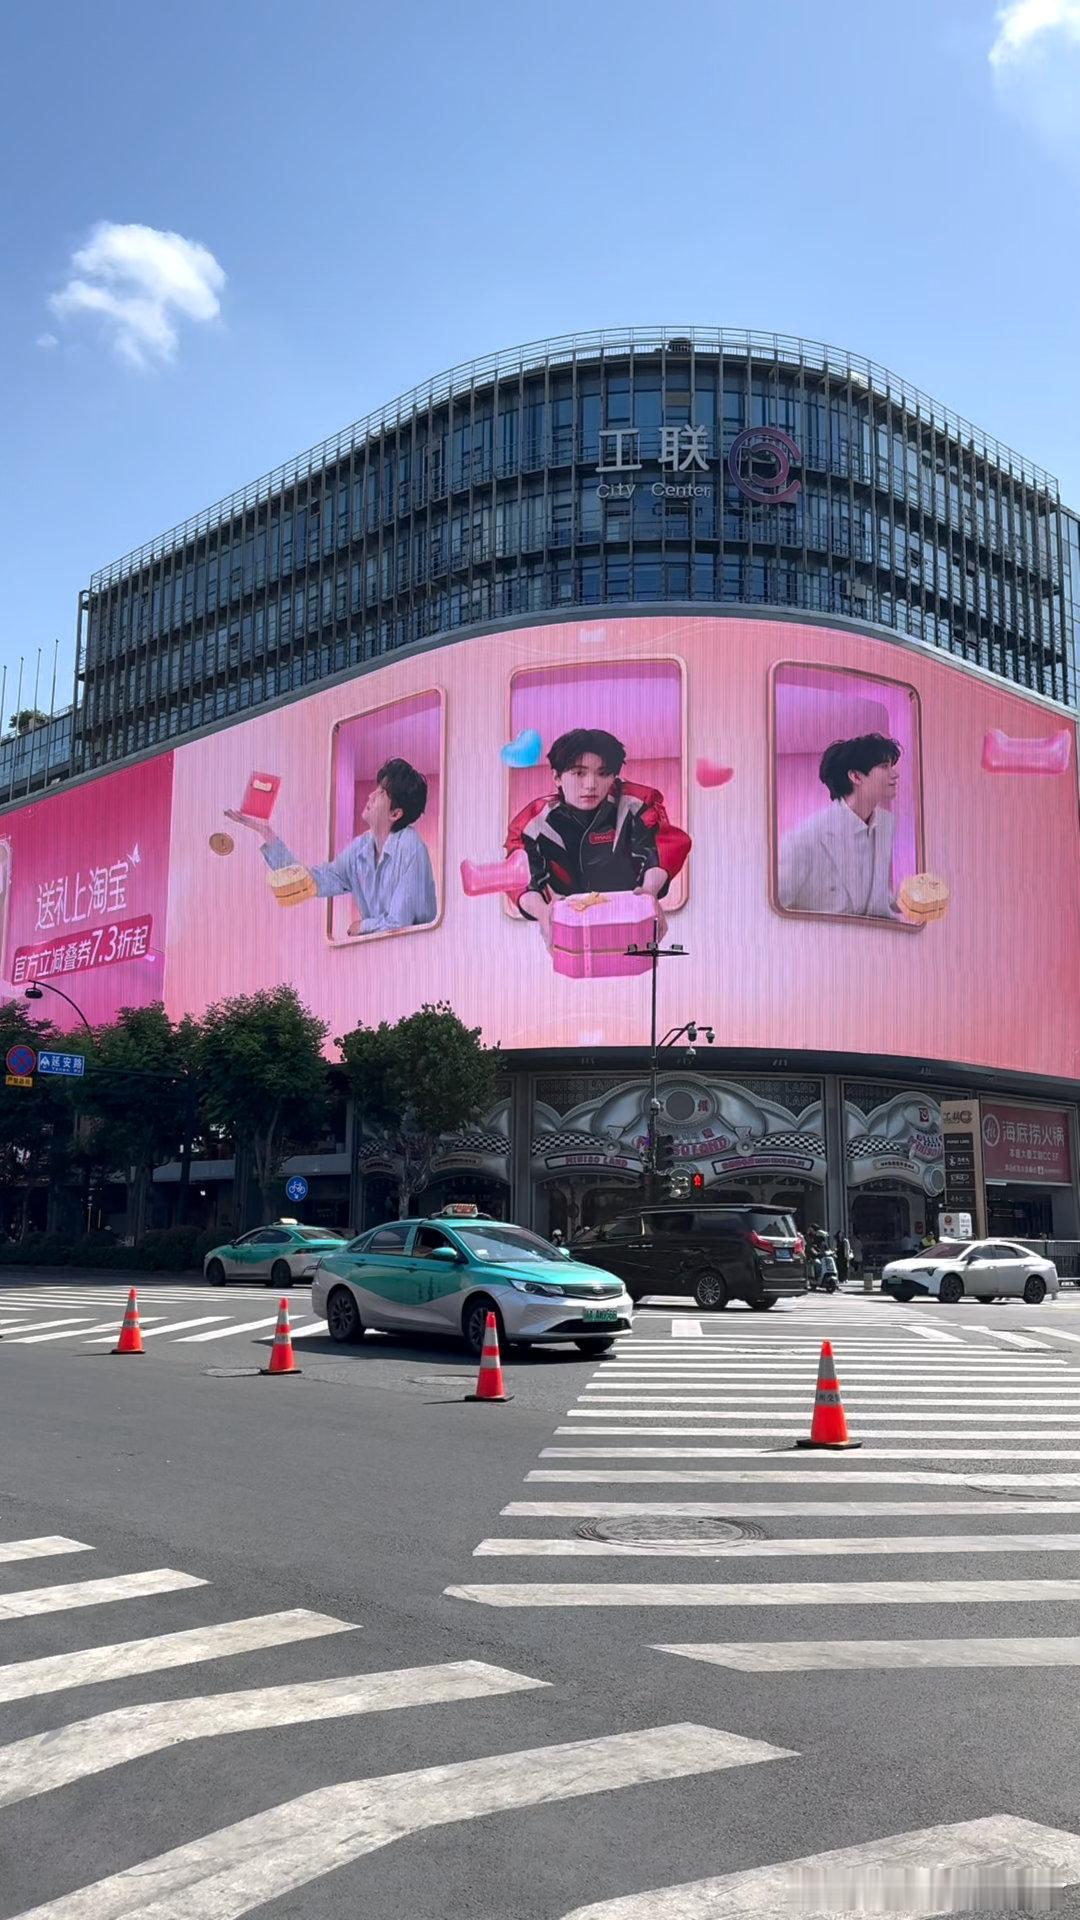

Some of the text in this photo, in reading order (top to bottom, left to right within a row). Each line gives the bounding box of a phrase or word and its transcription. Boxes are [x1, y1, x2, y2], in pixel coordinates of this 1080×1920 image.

[595, 424, 710, 473] 工联
[596, 482, 712, 499] City Center
[35, 859, 129, 932] 送礼上淘宝
[13, 925, 149, 982] 官方立减叠券7.3折起
[51, 1055, 82, 1069] 延安路
[1002, 1120, 1065, 1148] 海底捞火锅
